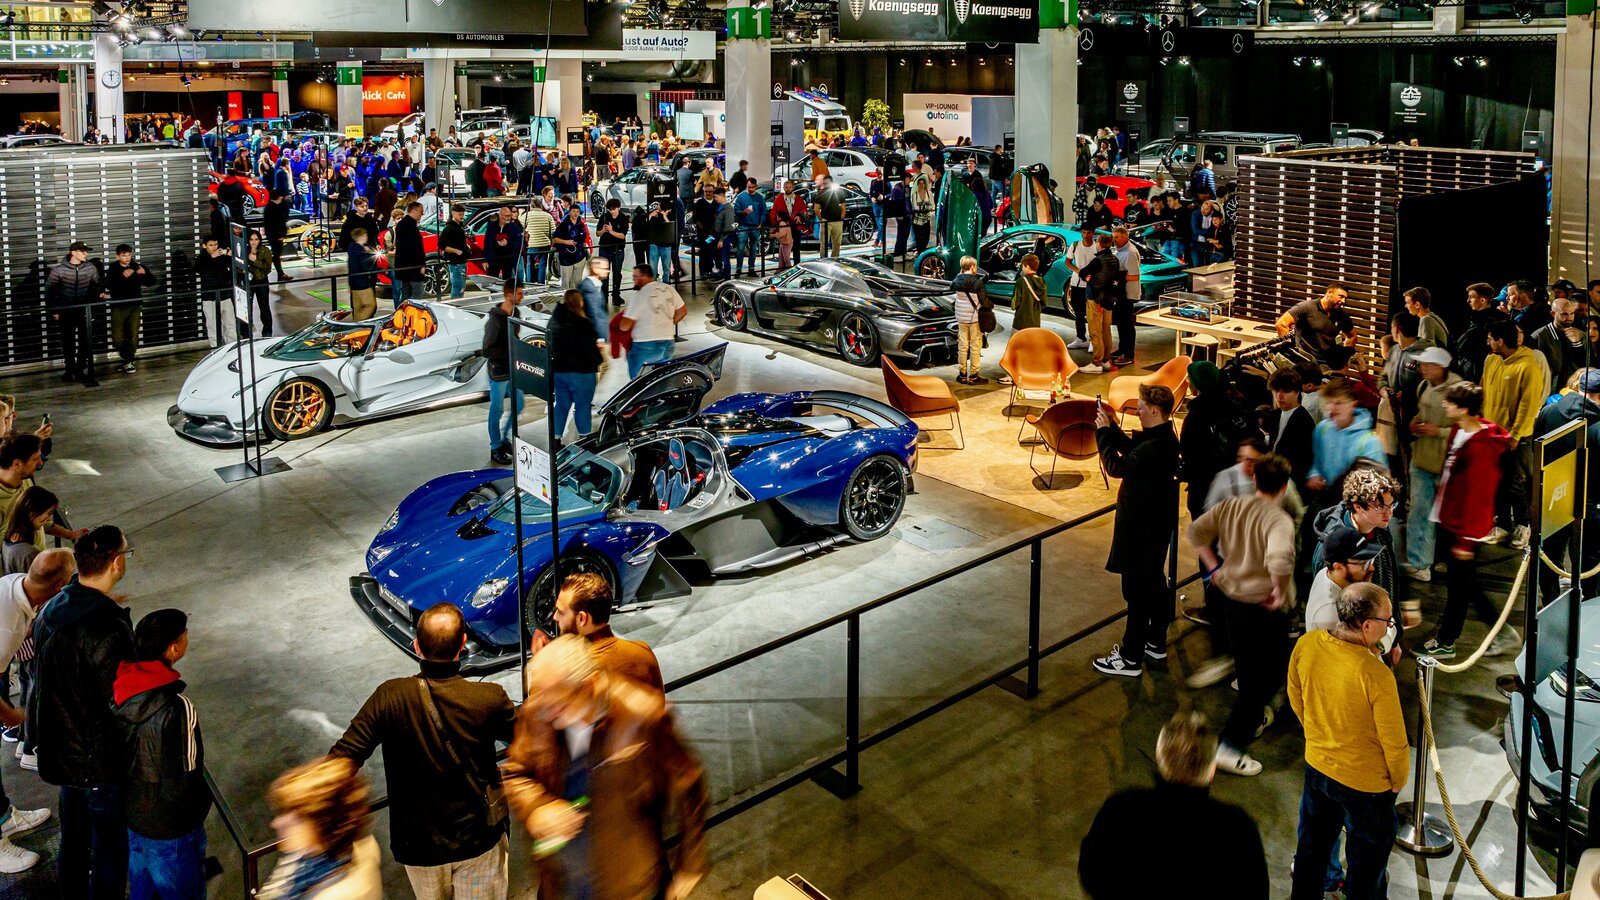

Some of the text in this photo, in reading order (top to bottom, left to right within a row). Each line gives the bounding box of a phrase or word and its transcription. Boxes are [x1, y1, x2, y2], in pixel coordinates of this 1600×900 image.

[868, 0, 939, 15] Koenigsegg
[972, 4, 1032, 19] Koenigsegg
[731, 11, 740, 35] 1
[752, 11, 762, 35] 1
[624, 37, 689, 46] ust auf Auto?
[348, 69, 357, 83] 1
[535, 68, 540, 81] 1
[386, 91, 406, 100] Café
